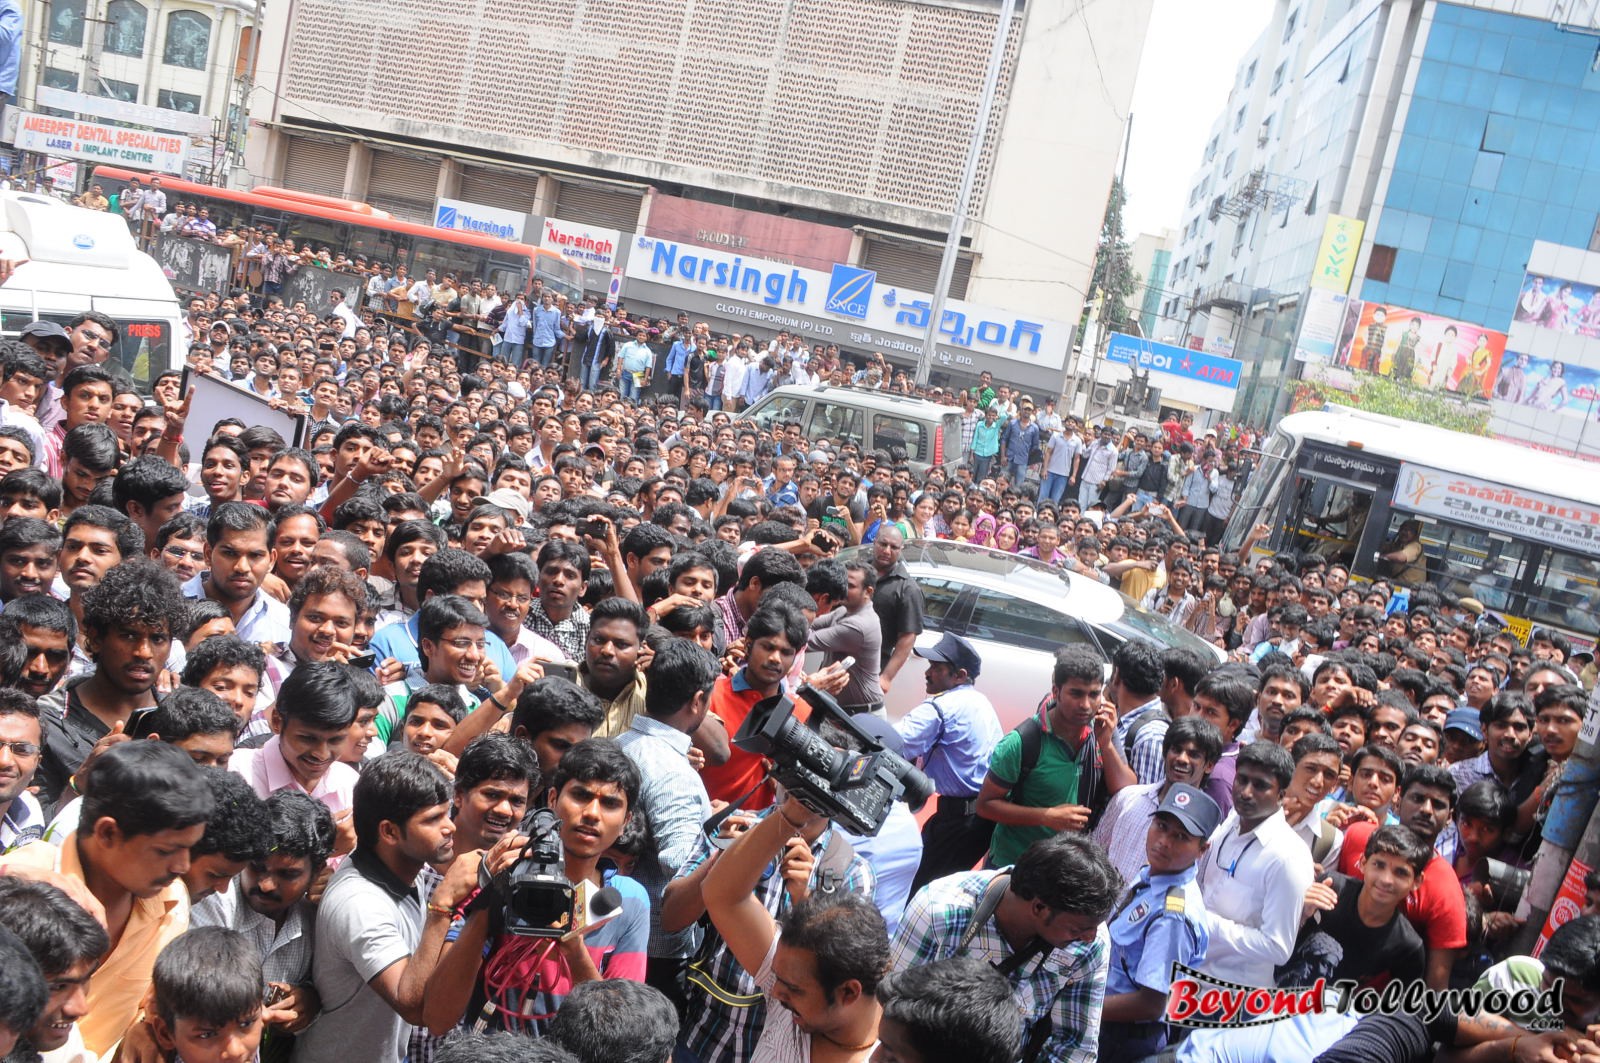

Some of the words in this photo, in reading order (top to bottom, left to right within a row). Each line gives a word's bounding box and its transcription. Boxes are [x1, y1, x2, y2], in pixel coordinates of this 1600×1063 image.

[24, 117, 75, 138] AMEERPET
[77, 123, 113, 144] DENTAL
[116, 130, 181, 155] SPECIALITIES
[45, 138, 72, 151] LASER
[82, 143, 119, 160] IMPLANT
[120, 149, 153, 163] CENTRE
[462, 215, 514, 238] Narsingh
[548, 228, 613, 254] Narsingh
[637, 236, 654, 251] Sri
[650, 240, 809, 306] Narsingh
[715, 303, 748, 318] CLOTH
[748, 310, 799, 328] EMPORIUM
[800, 319, 814, 332] (P)
[814, 325, 835, 336] LTD.
[828, 298, 866, 316] SNCE
[128, 324, 161, 338] PRESS
[1196, 364, 1234, 384] ATM
